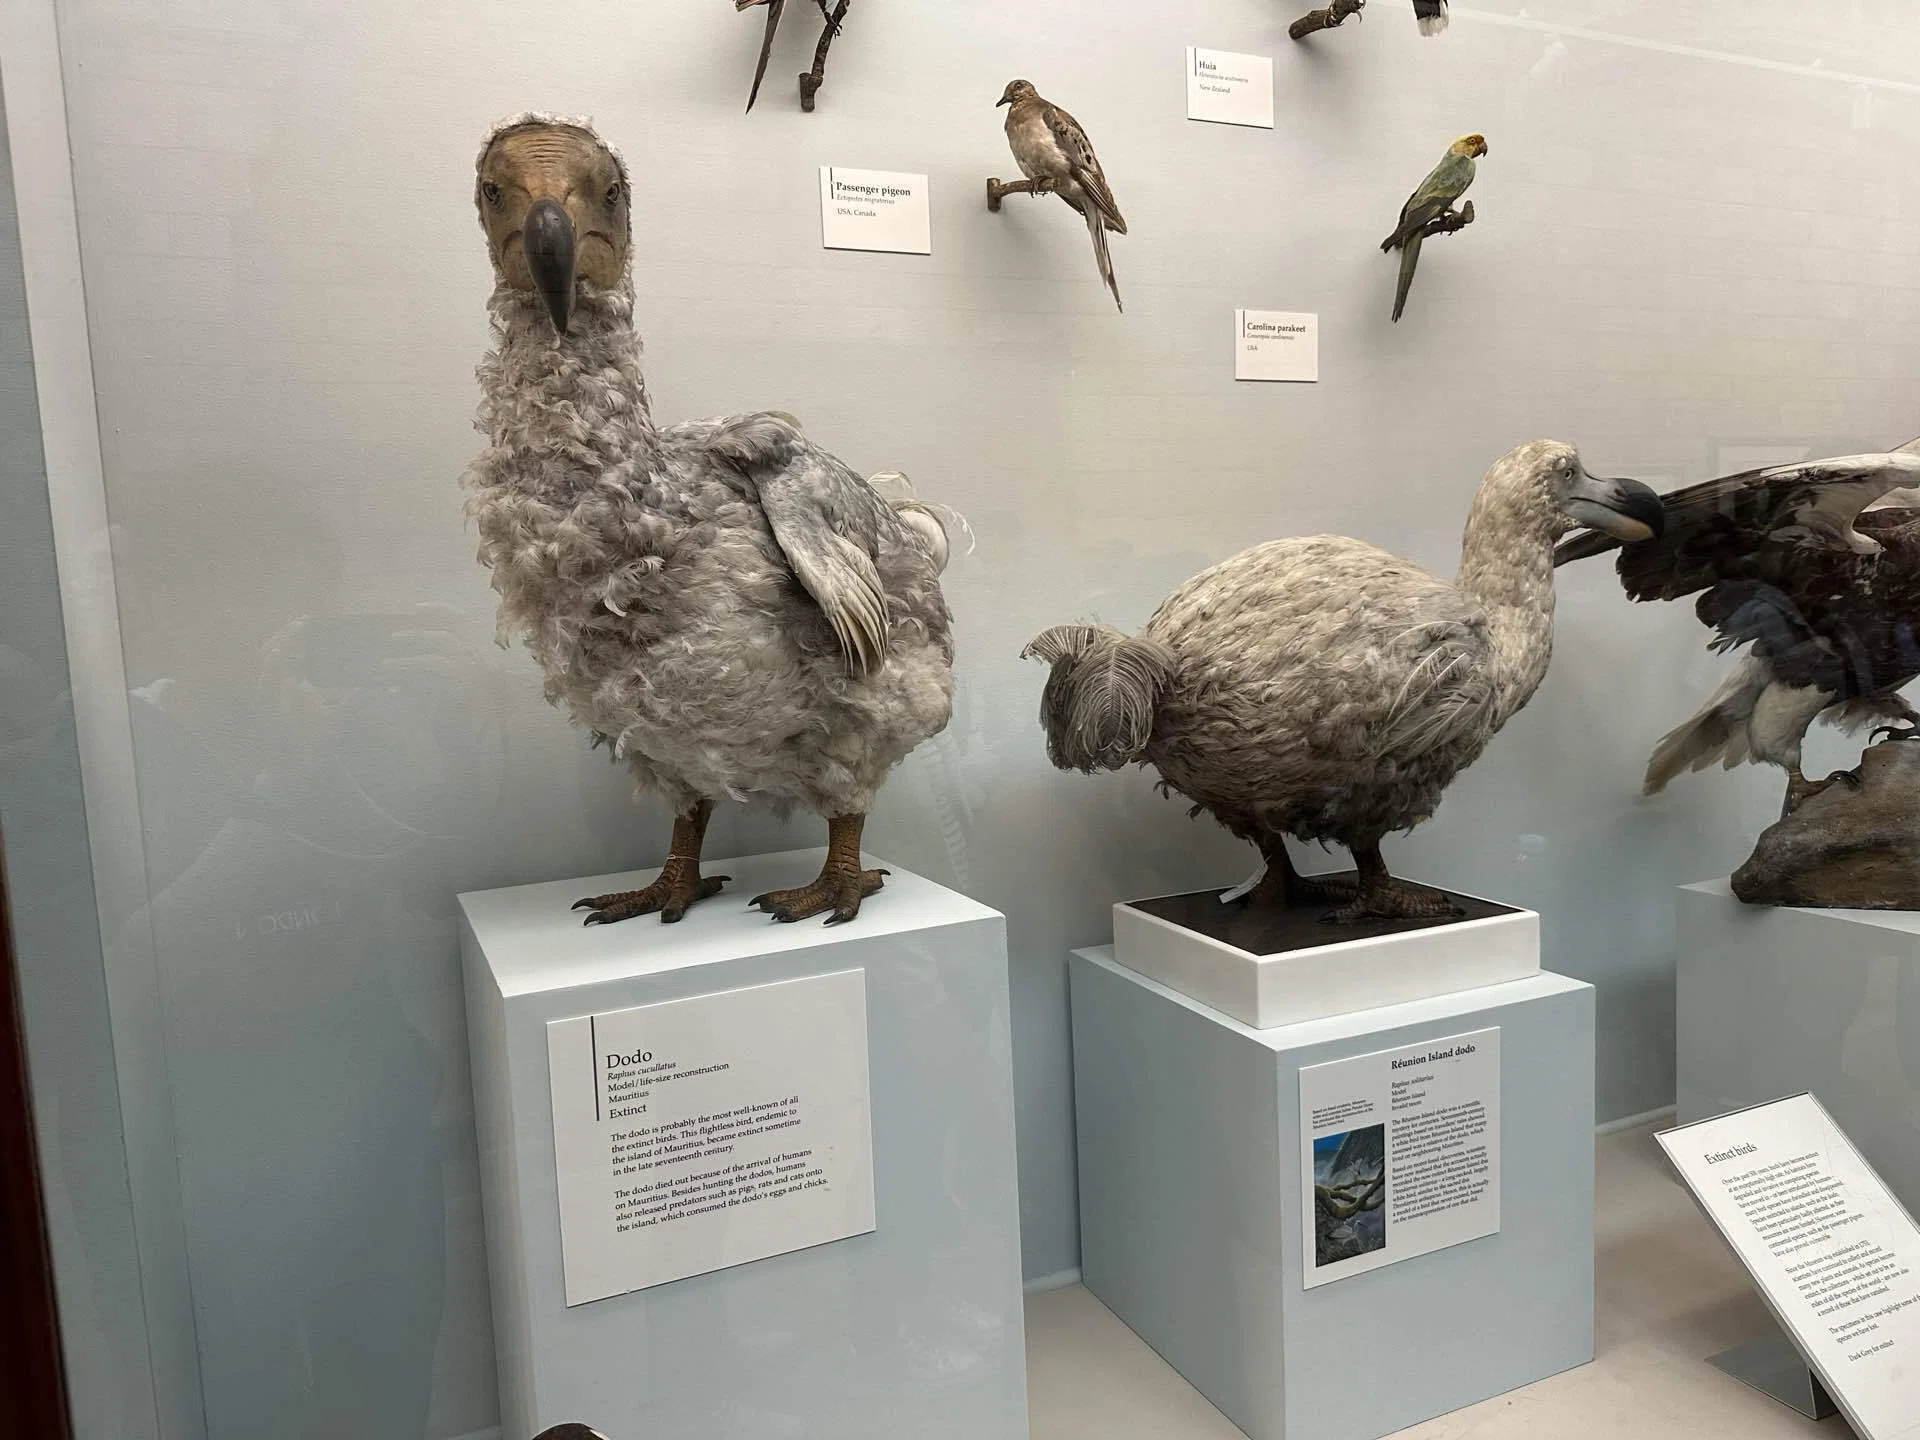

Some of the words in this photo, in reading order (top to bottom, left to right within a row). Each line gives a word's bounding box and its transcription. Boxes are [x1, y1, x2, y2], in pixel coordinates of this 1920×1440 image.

[1200, 61, 1216, 70] Huia
[837, 182, 879, 196] Passenger
[882, 186, 911, 197] pigeon
[1247, 322, 1275, 331] Carolina
[1277, 324, 1306, 334] parakeet
[607, 1049, 652, 1069] Dodo
[1392, 1056, 1426, 1069] Réunion
[1428, 1048, 1453, 1061] Island
[1455, 1044, 1475, 1056] dodo
[607, 1070, 636, 1081] Raphus
[637, 1062, 676, 1075] cucullatus
[608, 1075, 671, 1092] Model/life-size
[673, 1064, 729, 1079] reconstruction
[608, 1091, 649, 1104] Mauritius
[610, 1104, 647, 1119] Extinct
[610, 1132, 627, 1141] The
[628, 1128, 650, 1138] dodo
[660, 1118, 696, 1133] probably
[698, 1115, 710, 1123] the
[712, 1111, 731, 1120] most
[733, 1102, 778, 1116] well-known
[780, 1098, 788, 1106] of
[789, 1096, 798, 1104] all
[611, 1144, 625, 1153] the
[626, 1139, 654, 1150] extinct
[655, 1133, 678, 1144] birds.
[680, 1130, 698, 1138] This
[699, 1122, 734, 1135] flightless
[736, 1116, 754, 1127] bird,
[755, 1110, 787, 1122] endemic
[612, 1156, 626, 1164] the
[627, 1149, 652, 1161] island
[654, 1147, 662, 1155] of
[664, 1140, 705, 1154] Mauritius,
[707, 1133, 736, 1144] became
[738, 1126, 763, 1137] extinct
[765, 1119, 801, 1132] sometime
[623, 1165, 637, 1174] the
[638, 1163, 653, 1171] late
[655, 1150, 702, 1167] seventeenth
[1704, 1149, 1736, 1164] Extinct
[1732, 1143, 1757, 1156] birds
[614, 1190, 630, 1198] The
[632, 1184, 654, 1194] dodo
[655, 1179, 673, 1189] died
[675, 1177, 688, 1185] out
[690, 1170, 721, 1182] because
[722, 1166, 730, 1174] of
[732, 1164, 744, 1172] the
[746, 1157, 771, 1169] arrival
[772, 1155, 780, 1163] of
[782, 1150, 812, 1161] humans
[628, 1194, 670, 1207] Mauritius.
[671, 1186, 701, 1197] Besides
[702, 1178, 734, 1190] hunting
[735, 1174, 748, 1182] the
[749, 1169, 774, 1180] dodos,
[776, 1162, 806, 1174] humans
[616, 1212, 633, 1221] also
[634, 1202, 667, 1217] released
[669, 1196, 707, 1210] predators
[708, 1189, 727, 1200] such
[774, 1174, 788, 1184] and
[790, 1173, 804, 1181] cats
[806, 1169, 822, 1177] onto
[617, 1224, 630, 1232] the
[632, 1217, 658, 1229] island,
[660, 1210, 685, 1222] which
[686, 1200, 726, 1216] consumed
[728, 1198, 740, 1206] the
[742, 1192, 768, 1203] dodo's
[769, 1188, 787, 1198] eggs
[788, 1182, 802, 1192] and
[804, 1178, 828, 1189] chicks.
